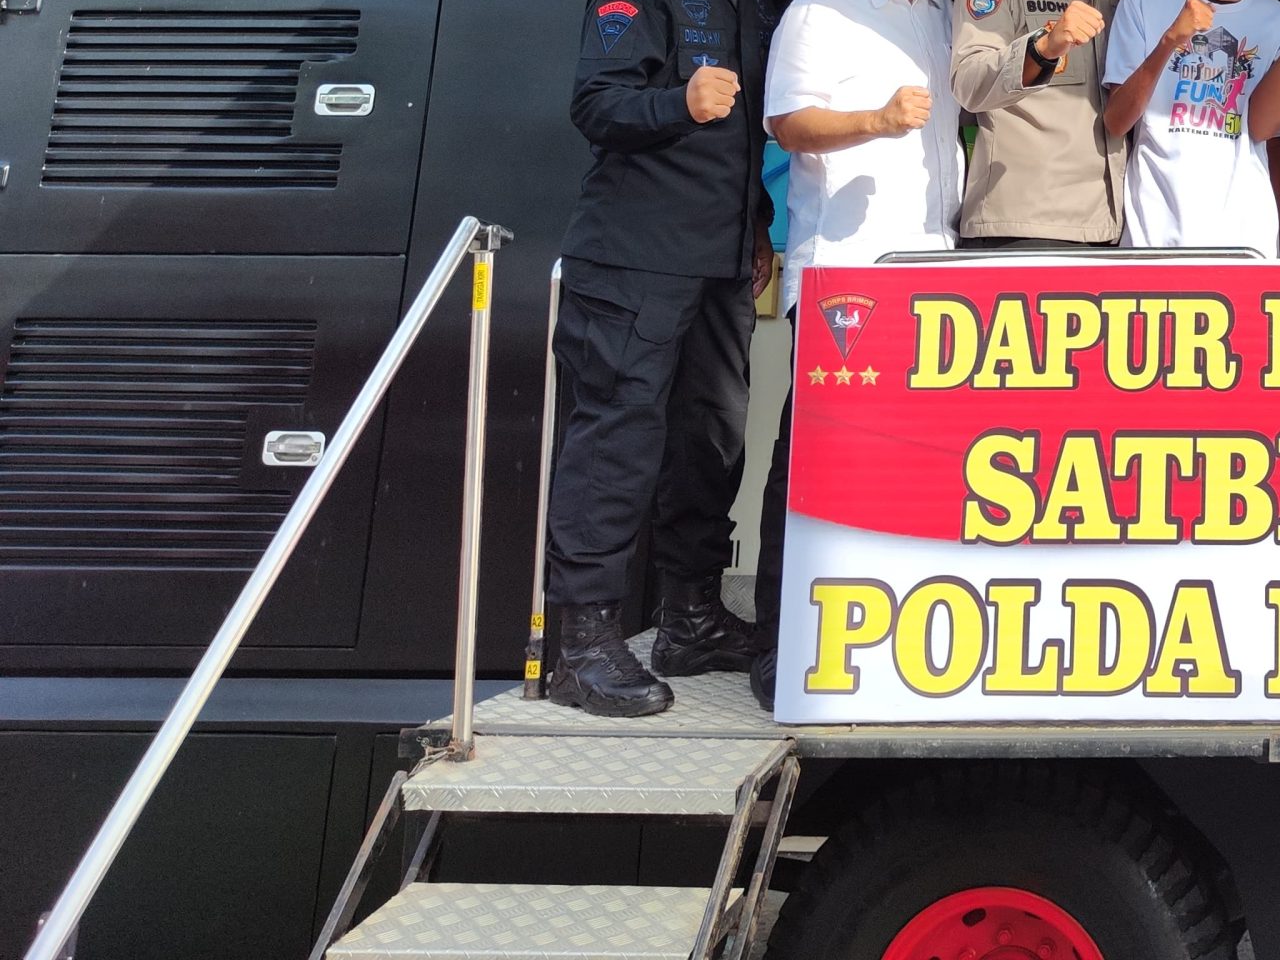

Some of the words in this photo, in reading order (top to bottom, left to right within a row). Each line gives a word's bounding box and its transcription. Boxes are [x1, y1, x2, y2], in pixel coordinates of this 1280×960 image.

[1174, 80, 1223, 102] FUN
[1169, 102, 1225, 131] RUN
[1168, 127, 1209, 136] KALTENG
[1213, 131, 1242, 140] BERKA
[907, 292, 1242, 391] DAPUR
[532, 616, 542, 628] A2
[804, 575, 1242, 698] POLDA
[527, 663, 538, 675] A2
